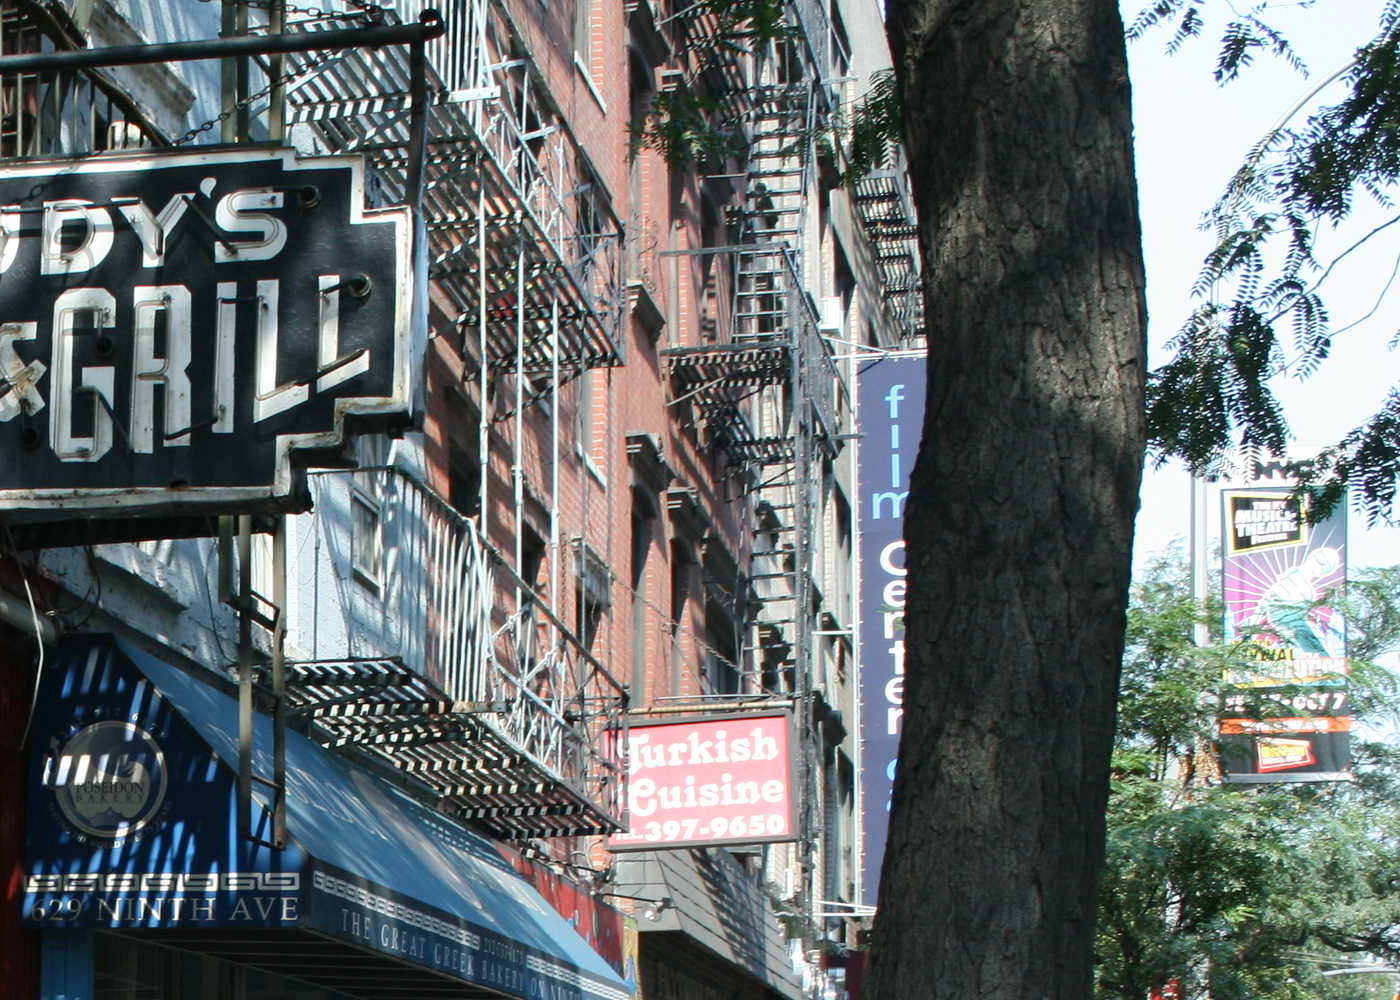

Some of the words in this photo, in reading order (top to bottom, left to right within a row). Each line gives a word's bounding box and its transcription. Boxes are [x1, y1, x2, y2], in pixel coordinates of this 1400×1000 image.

[49, 274, 371, 464] GRILL
[617, 728, 779, 774] Turkish
[76, 782, 143, 794] POSEIDON
[617, 773, 785, 816] Cuisine
[645, 814, 785, 841] 397-9650
[31, 898, 82, 921] 629
[98, 897, 216, 921] NINTH
[231, 897, 299, 921] AVE
[341, 908, 371, 939] THE
[381, 924, 425, 959] GREAT
[434, 943, 474, 977] GREEK
[481, 959, 525, 992] BAKERY
[530, 977, 545, 1000] ON
